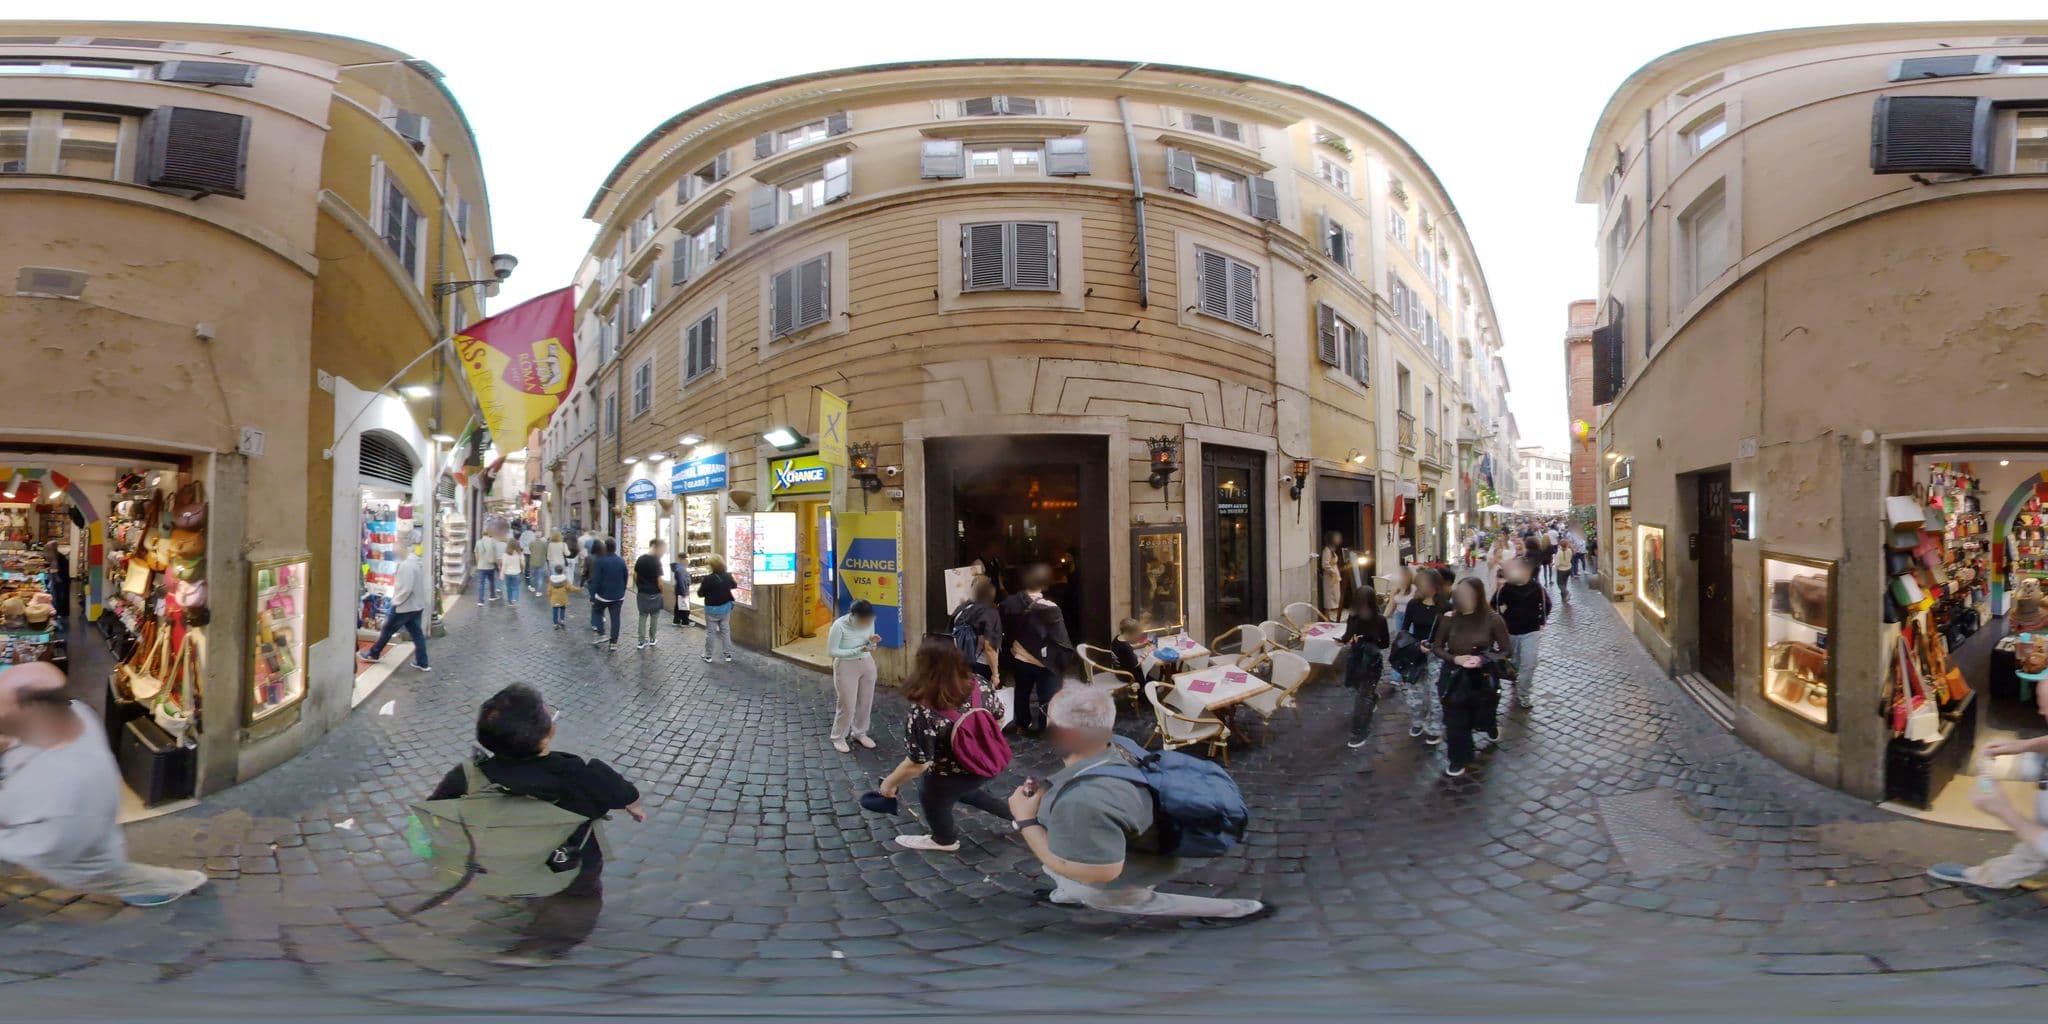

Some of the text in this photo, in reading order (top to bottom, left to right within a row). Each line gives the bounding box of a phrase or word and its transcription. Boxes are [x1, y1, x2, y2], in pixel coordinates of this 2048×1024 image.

[458, 337, 486, 362] AS
[519, 353, 537, 391] ROMA
[772, 459, 826, 490] XCHANGE
[845, 558, 895, 571] CHANGE
[853, 576, 872, 586] VISA
